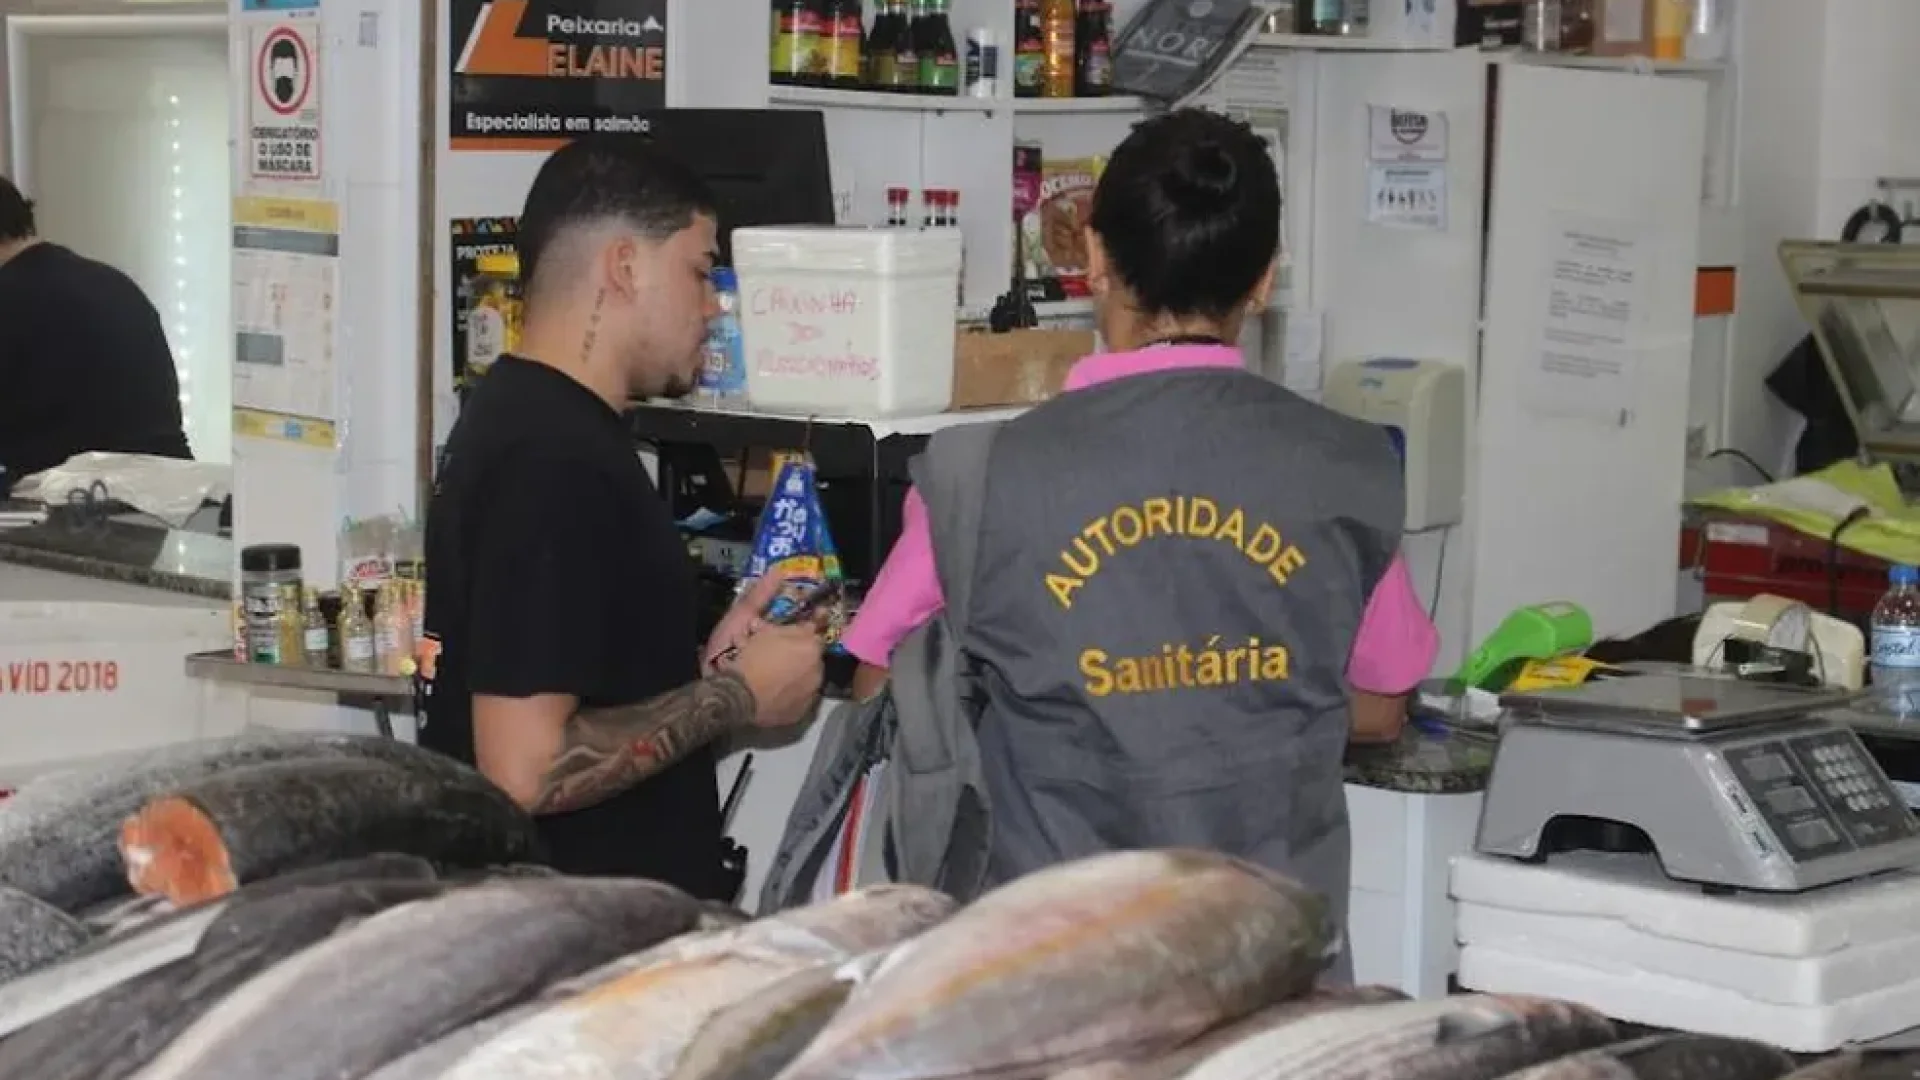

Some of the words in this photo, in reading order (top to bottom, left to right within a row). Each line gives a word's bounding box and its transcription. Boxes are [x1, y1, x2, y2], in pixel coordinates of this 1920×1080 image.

[547, 14, 641, 36] Peixaria
[547, 42, 664, 79] ELAINE
[1127, 28, 1225, 61] NORI
[465, 112, 561, 133] Especialista
[565, 116, 590, 132] em
[595, 114, 650, 133] salmão
[258, 142, 268, 156] O
[270, 142, 293, 156] USO
[296, 142, 311, 156] DE
[1045, 495, 1308, 610] AUTORIDADE
[57, 660, 118, 693] 2018
[1078, 634, 1290, 697] Sanitária
